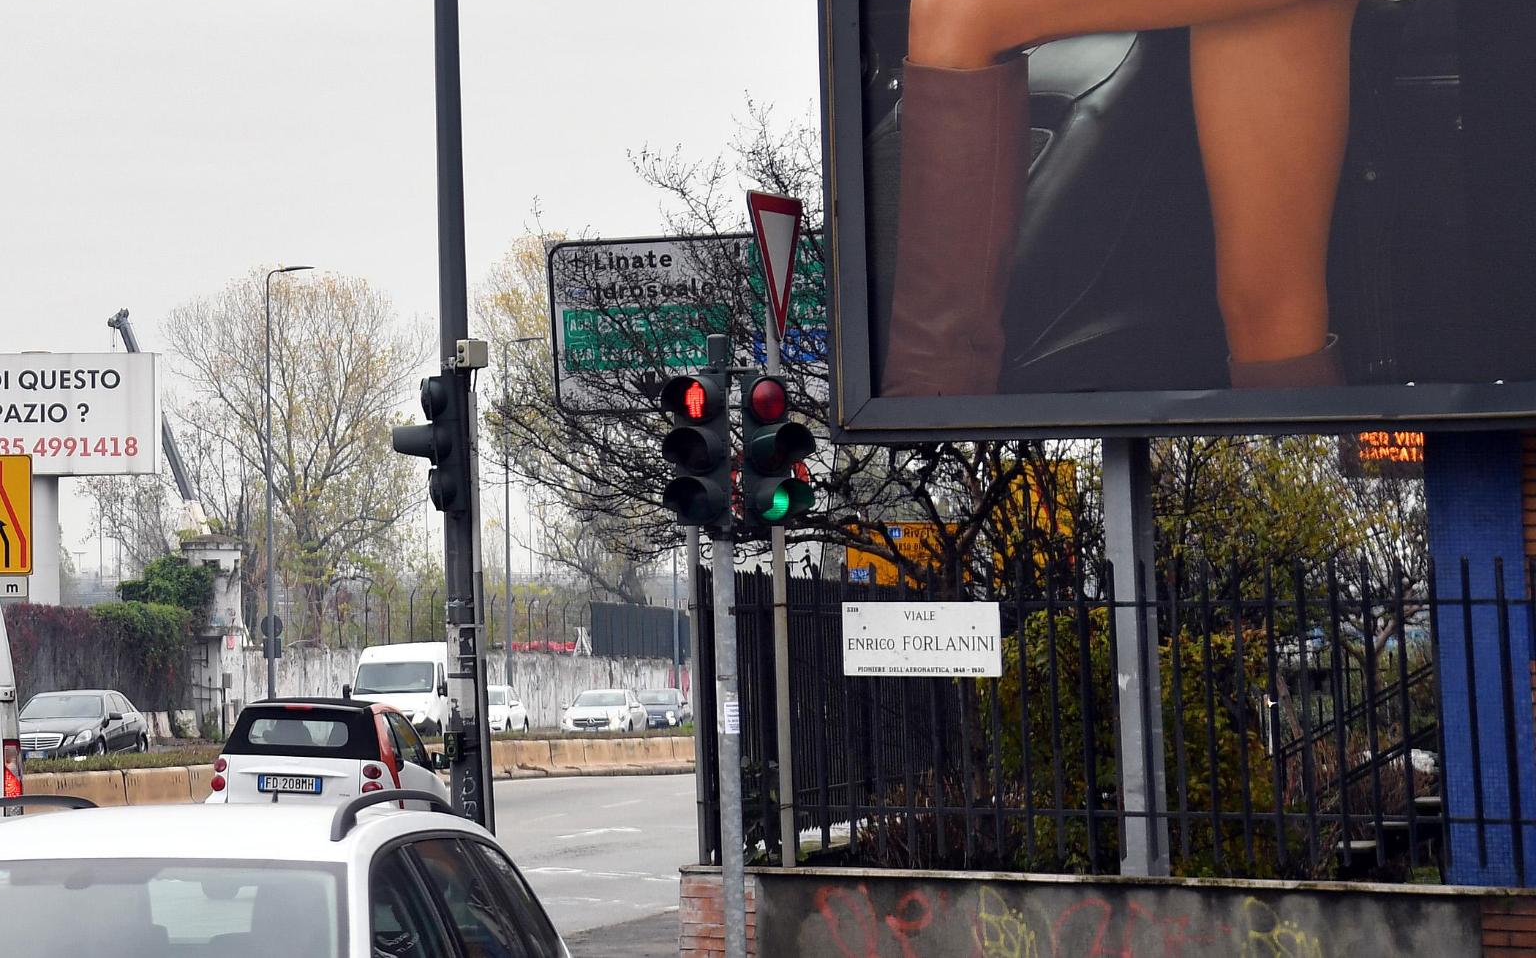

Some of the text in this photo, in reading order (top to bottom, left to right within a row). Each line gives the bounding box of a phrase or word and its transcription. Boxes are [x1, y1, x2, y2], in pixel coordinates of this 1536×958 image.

[593, 250, 673, 270] Linate
[18, 369, 121, 390] QUESTO
[76, 403, 90, 423] ?
[33, 436, 139, 457] 4991418
[6, 583, 19, 593] m
[904, 611, 936, 621] VIALE
[848, 635, 995, 652] ENRICO FORLANINI
[889, 666, 950, 674] DELL'AERONAUTICA
[265, 777, 314, 790] FD 208MH
